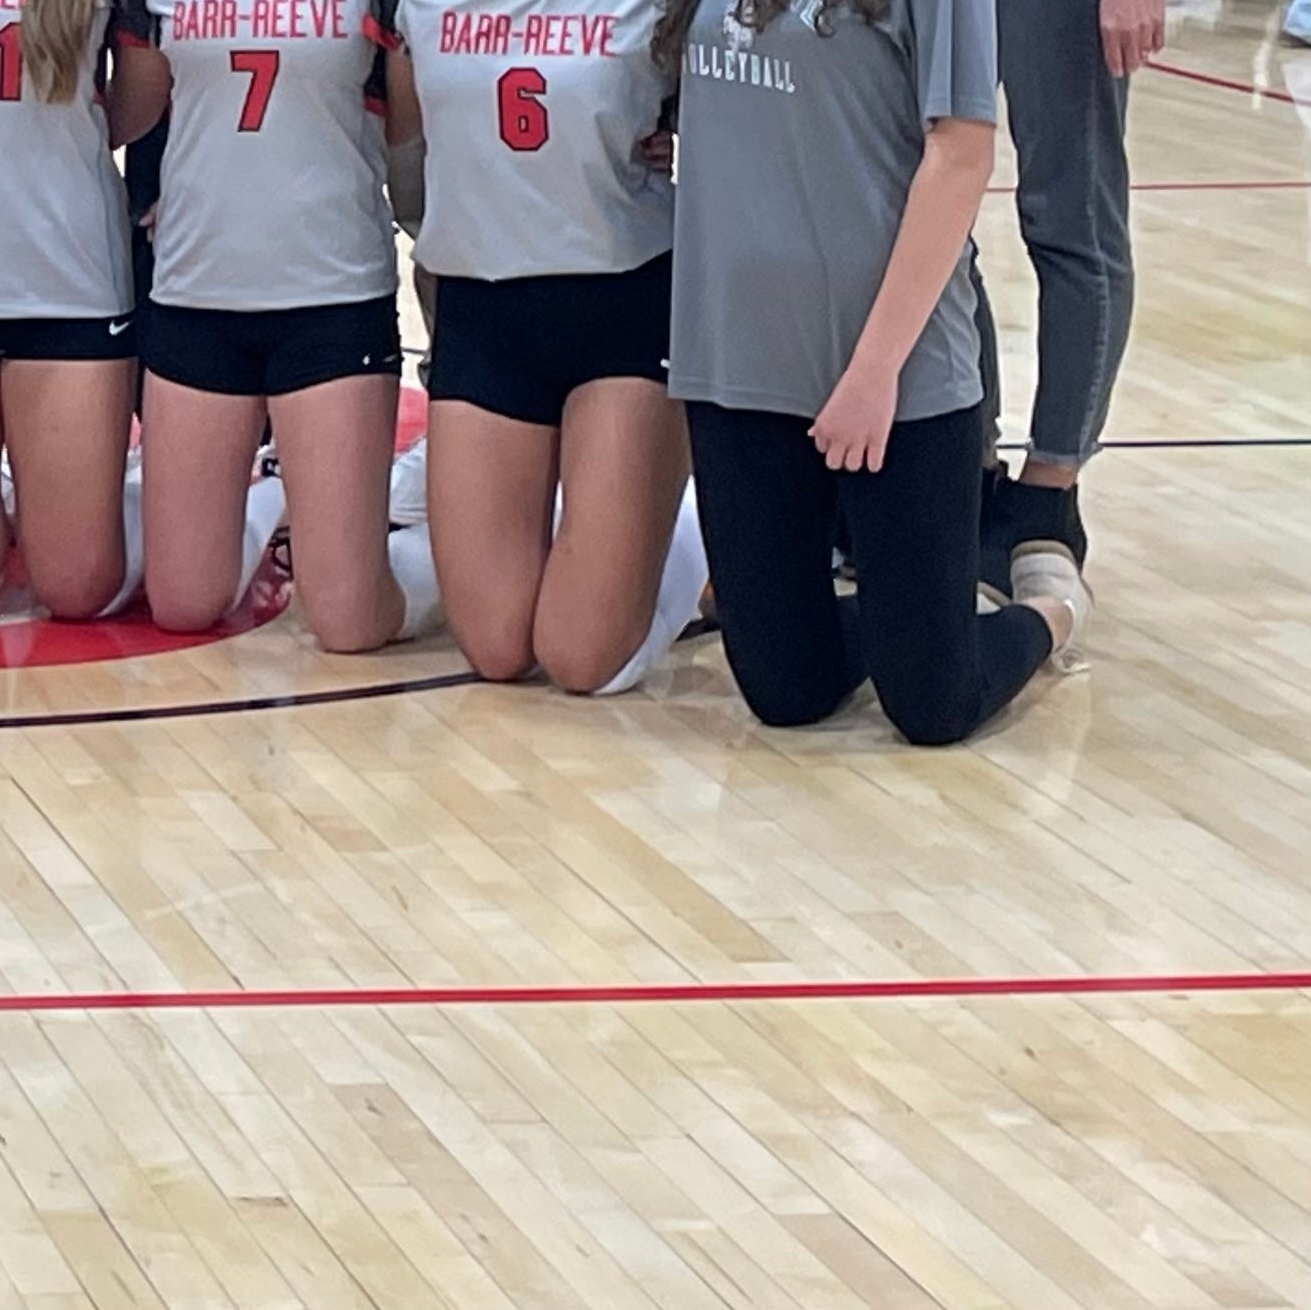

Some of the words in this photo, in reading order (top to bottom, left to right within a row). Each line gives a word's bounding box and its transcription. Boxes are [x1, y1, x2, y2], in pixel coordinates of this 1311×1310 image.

[440, 10, 619, 57] BARR-REEVE
[230, 50, 279, 132] 7
[688, 43, 795, 93] OLLEYBALL
[497, 67, 549, 151] 6
